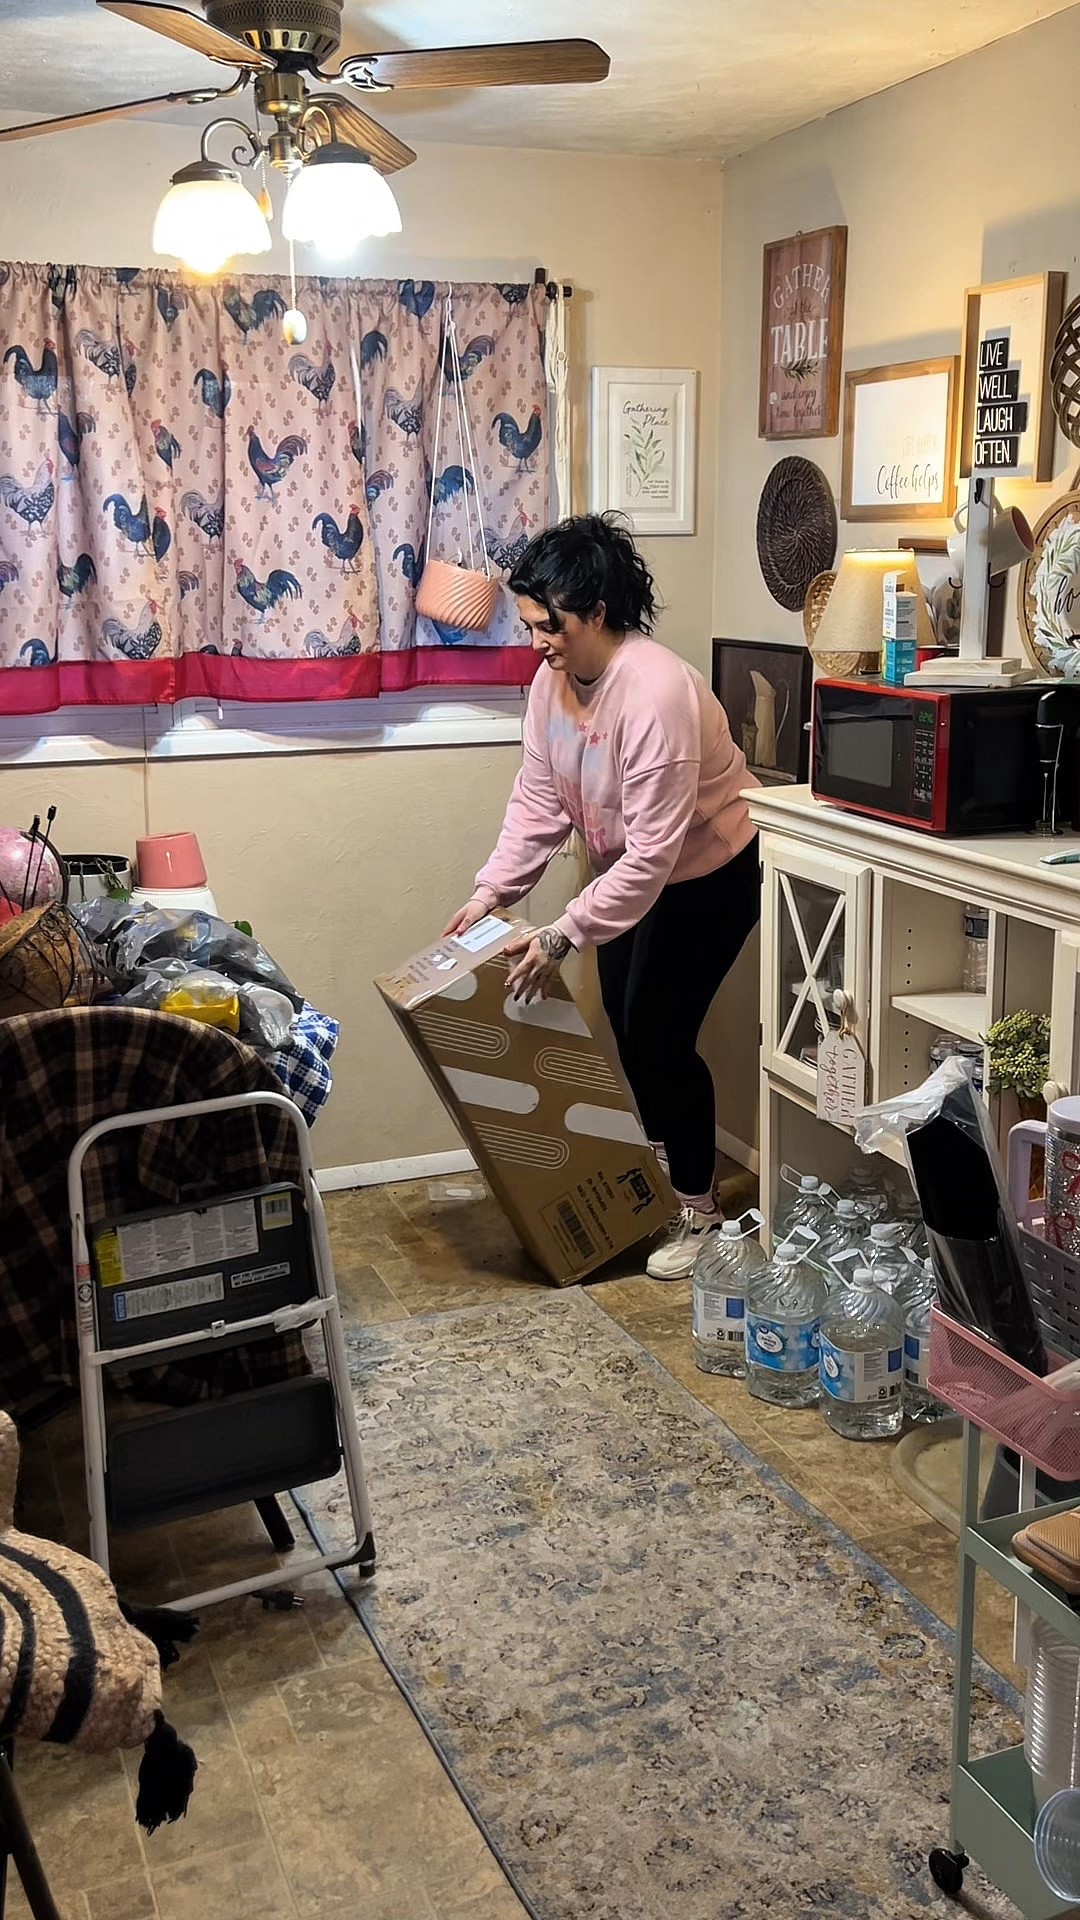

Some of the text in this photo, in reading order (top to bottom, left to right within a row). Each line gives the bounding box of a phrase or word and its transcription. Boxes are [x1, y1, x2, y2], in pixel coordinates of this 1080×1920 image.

[773, 263, 830, 309] GATHER
[771, 318, 828, 364] TABLE
[980, 341, 1004, 368] LIVE
[622, 400, 669, 416] Gathering
[642, 414, 670, 428] Place
[977, 406, 1014, 433] LAUGH
[975, 439, 1012, 465] OFTEN.
[877, 464, 939, 499] Coffee helps
[819, 1045, 839, 1118] together
[841, 1048, 857, 1118] GATHER
